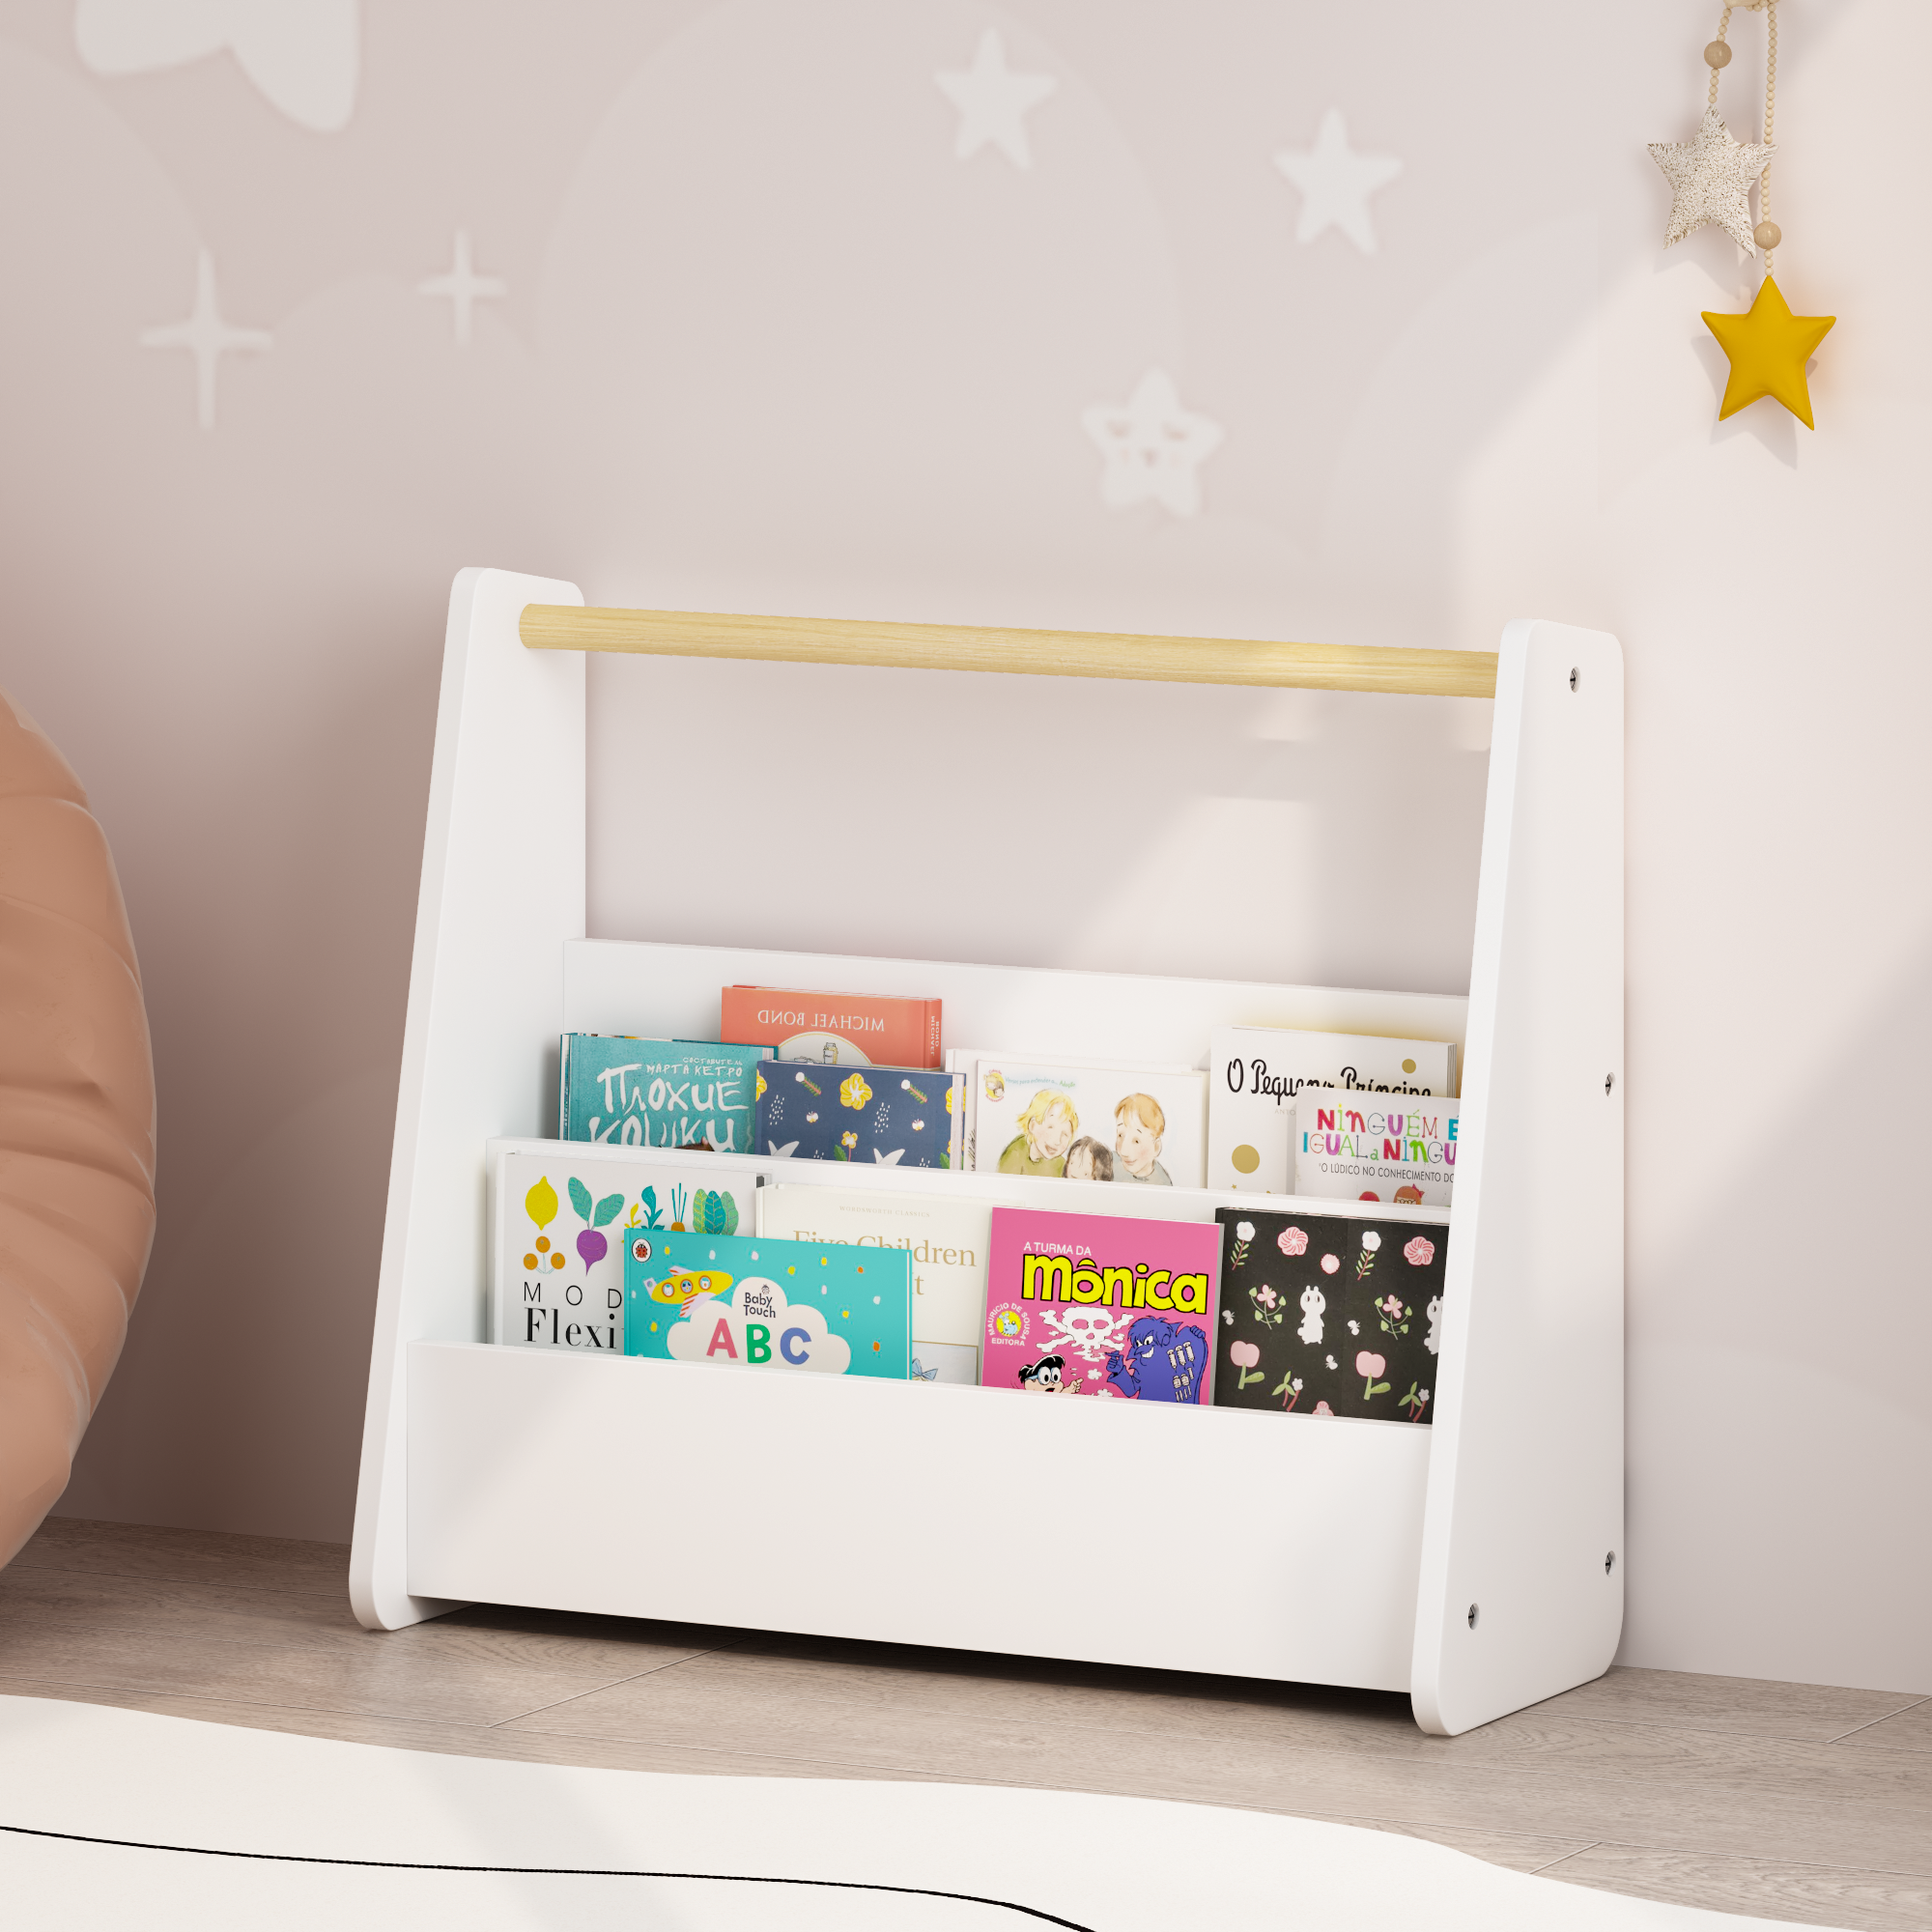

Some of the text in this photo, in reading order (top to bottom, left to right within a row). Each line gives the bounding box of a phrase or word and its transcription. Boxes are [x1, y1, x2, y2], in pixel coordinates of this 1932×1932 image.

[646, 1064, 743, 1077] МАРТА КЕТРО
[1227, 1058, 1244, 1093] O
[1303, 1131, 1369, 1158] IGUAL
[1370, 1149, 1379, 1160] a
[1330, 1162, 1360, 1176] LÚDICO
[1362, 1166, 1376, 1177] NO
[1378, 1167, 1441, 1182] CONHECIMENTO
[838, 1205, 893, 1215] WORDSWORTH
[1023, 1241, 1092, 1257] A TURMA DA
[744, 1292, 773, 1308] Baby
[743, 1304, 777, 1319] Touch
[524, 1306, 624, 1350] Flexi
[987, 1302, 1031, 1340] MAURICIO DE SOUSA
[706, 1318, 811, 1365] ABC
[991, 1337, 1025, 1347] EDITORA
